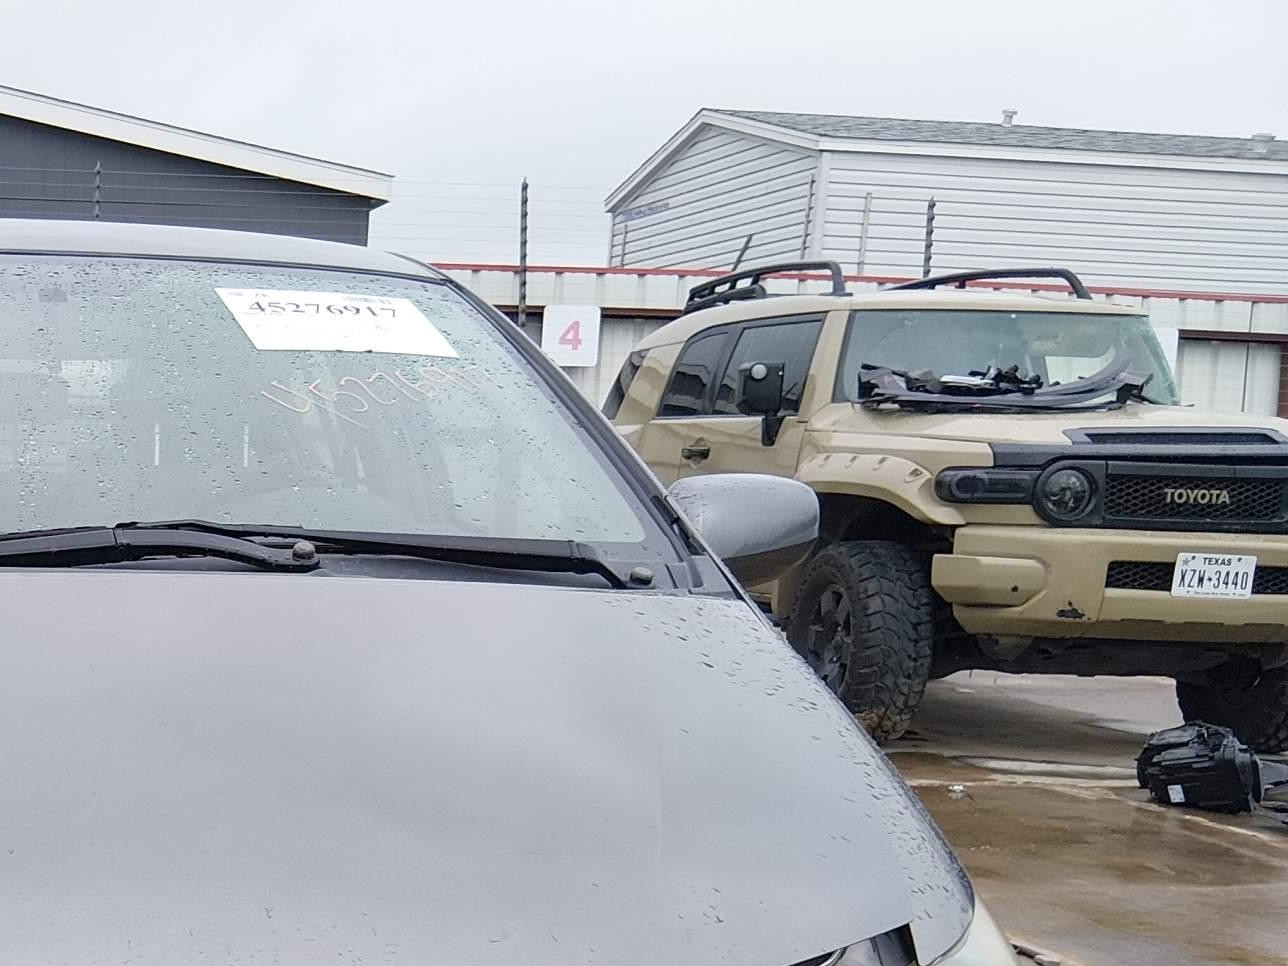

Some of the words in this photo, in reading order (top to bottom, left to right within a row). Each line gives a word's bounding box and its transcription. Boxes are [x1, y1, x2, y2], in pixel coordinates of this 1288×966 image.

[249, 300, 397, 319] 45276917
[558, 320, 583, 351] 4
[1164, 489, 1230, 504] TOYOTA
[1203, 558, 1232, 566] TEXAS
